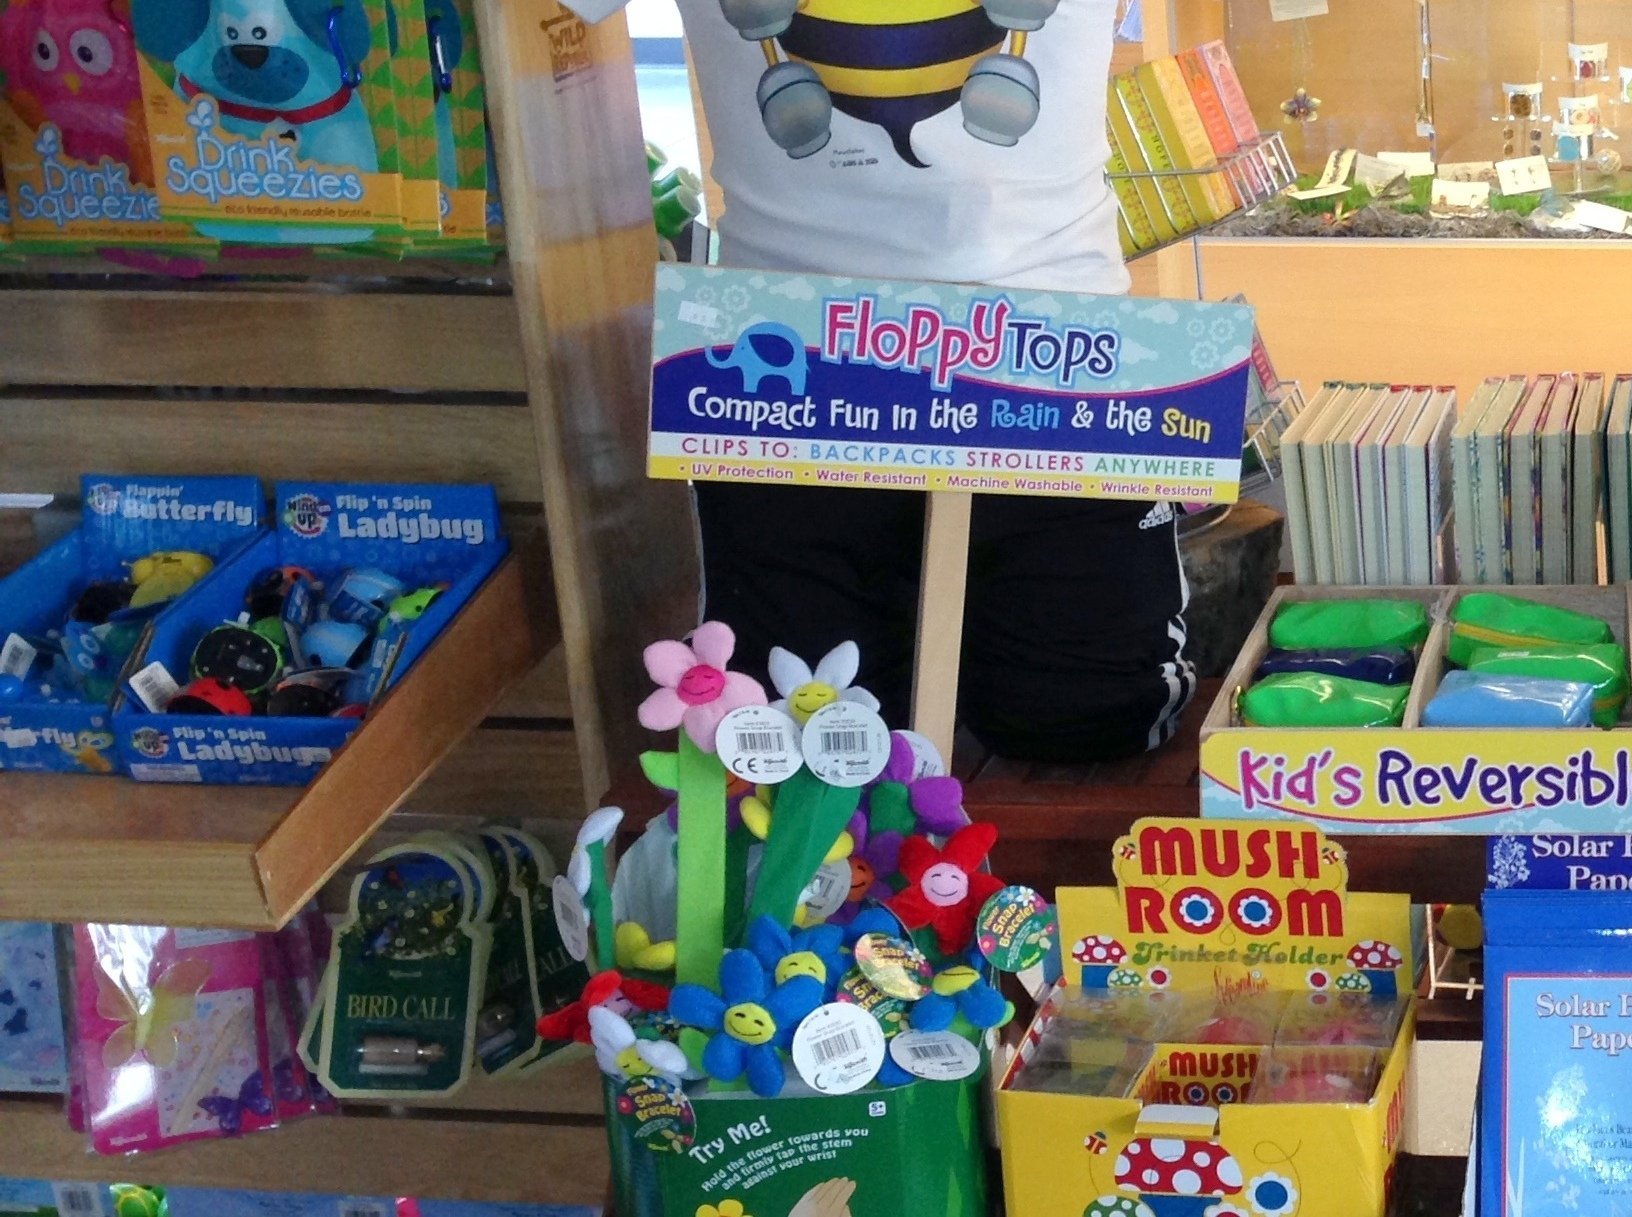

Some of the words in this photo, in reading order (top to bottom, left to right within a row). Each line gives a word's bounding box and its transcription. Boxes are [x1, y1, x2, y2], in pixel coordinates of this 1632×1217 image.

[197, 132, 296, 172] Drink
[44, 161, 128, 196] Drink
[166, 154, 363, 203] Squeezies
[18, 184, 162, 226] Squeezie
[687, 386, 816, 431] Compact
[830, 398, 880, 431] Fun
[892, 404, 917, 431] In
[929, 397, 978, 434] the
[991, 398, 1061, 432] Rain
[1071, 400, 1094, 429] &
[1105, 398, 1153, 437] the
[1161, 406, 1212, 444] Sun
[682, 436, 749, 457] CLIPS
[759, 441, 798, 460] TO:
[810, 443, 956, 467] BACKPACKS
[966, 451, 1084, 472] STROLLERS
[1094, 456, 1216, 478] ANYWHERE
[691, 463, 712, 476] UV
[718, 464, 794, 480] Protection
[816, 469, 861, 483] Water
[863, 471, 926, 486] Resistant
[946, 475, 1010, 489] Machine
[1014, 477, 1083, 492] Washable
[1100, 481, 1150, 495] Wrinkle
[1154, 483, 1213, 497] Resistant
[123, 498, 253, 527] Butterfly
[335, 494, 370, 511] Flip
[392, 495, 432, 512] Spin
[337, 511, 484, 545] Ladybug
[1138, 509, 1174, 530] adidas
[172, 726, 206, 740] Flip
[227, 727, 267, 741] Spin
[1238, 748, 1363, 809] Kid's
[1138, 825, 1321, 880] MUSH
[1531, 834, 1614, 858] Solar
[992, 902, 1017, 934] Snap
[998, 902, 1036, 948] Bracelet
[1124, 885, 1345, 938] ROOM
[1131, 941, 1239, 966] Trinket
[1242, 941, 1344, 967] Holder
[347, 993, 399, 1019] BIRD
[401, 994, 456, 1021] CALL
[1536, 992, 1612, 1019] Solar
[1168, 1051, 1257, 1078] MUSH
[634, 1093, 666, 1109] Snap
[636, 1103, 682, 1122] Bracelet
[688, 1137, 725, 1165] Try
[726, 1114, 772, 1145] Me!
[701, 1168, 727, 1192] Hold
[726, 1158, 747, 1173] the
[746, 1139, 785, 1160] flower
[787, 1128, 841, 1147] towards
[844, 1128, 869, 1138] you
[721, 1174, 742, 1191] and
[740, 1156, 775, 1178] firmly
[776, 1148, 796, 1162] tap
[798, 1141, 819, 1154] the
[821, 1139, 853, 1150] stem
[741, 1165, 778, 1190] against
[778, 1155, 805, 1171] your
[806, 1149, 838, 1163] wrist
